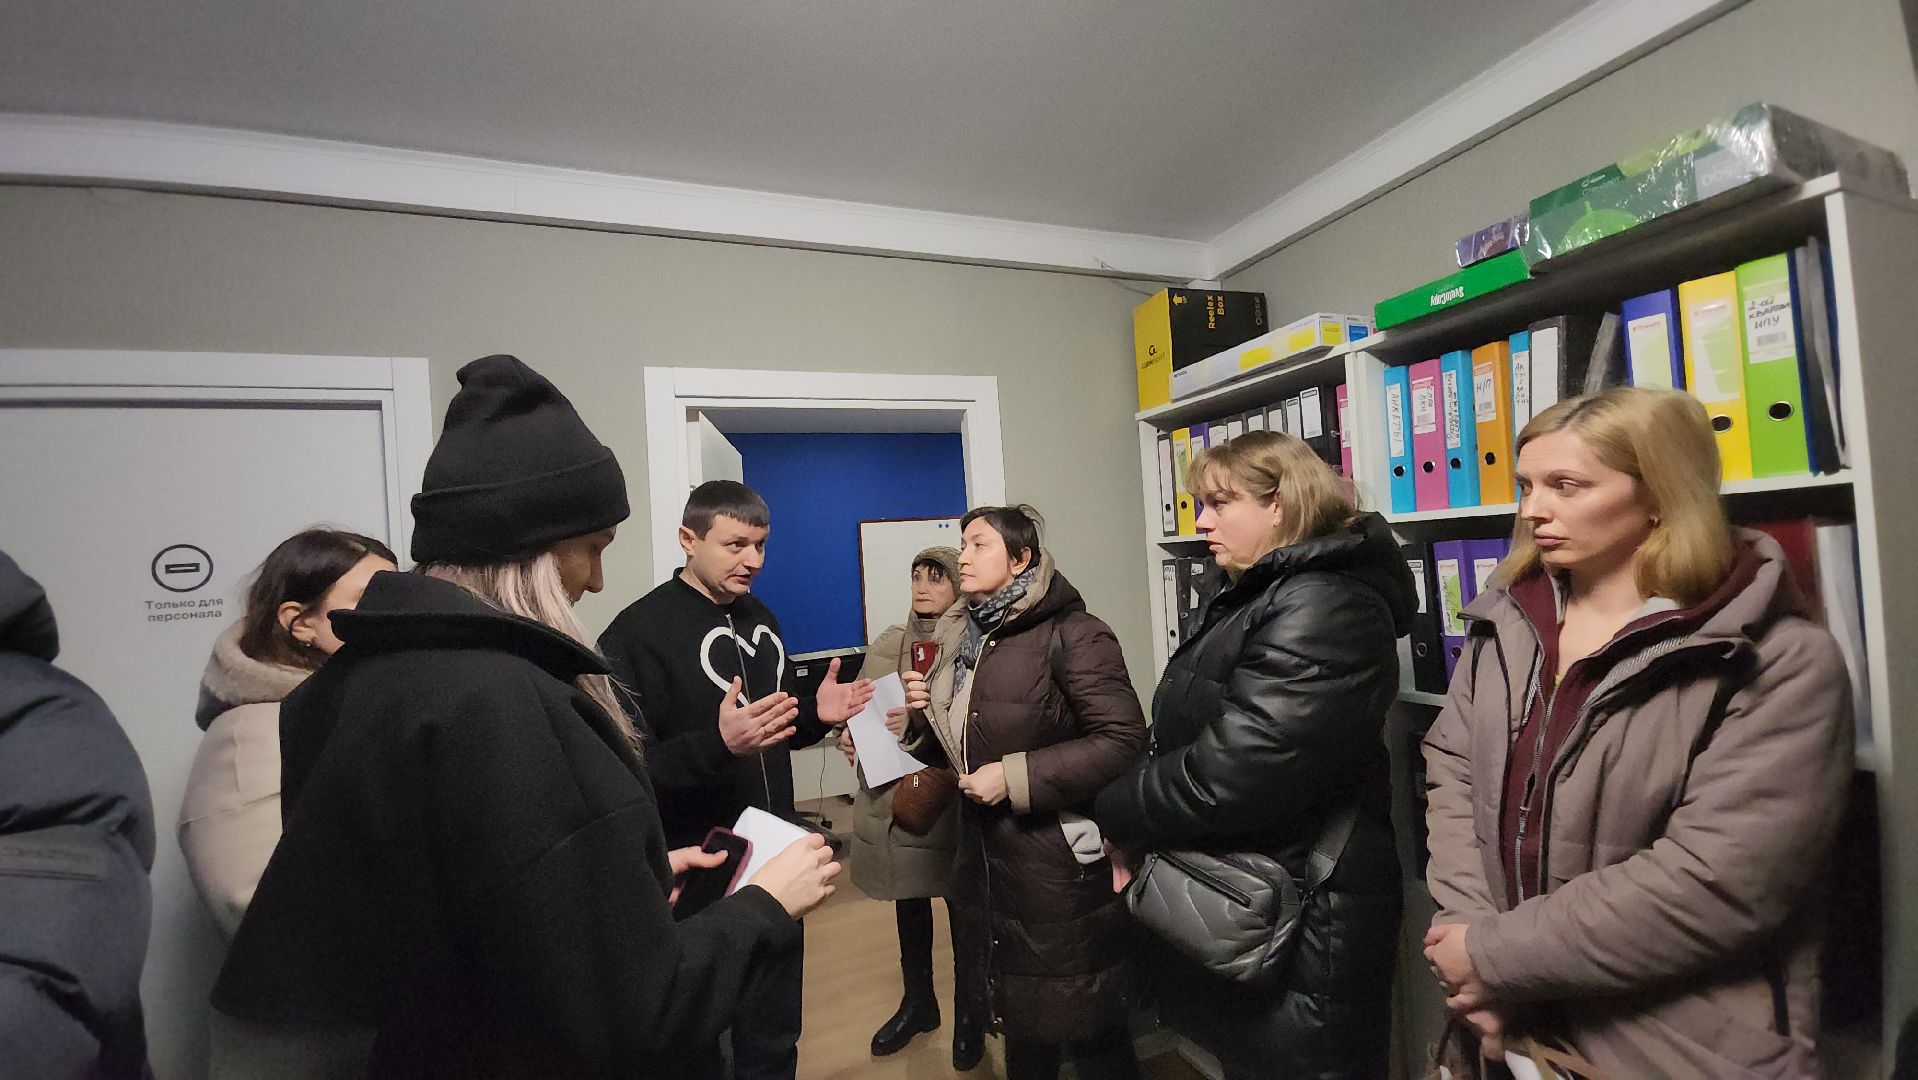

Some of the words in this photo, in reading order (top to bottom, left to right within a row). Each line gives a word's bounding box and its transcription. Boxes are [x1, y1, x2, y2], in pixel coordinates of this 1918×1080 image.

[1217, 295, 1225, 316] Box
[1430, 286, 1465, 307] SvetoCopy
[1207, 294, 1216, 329] Reelex
[145, 600, 196, 611] Только
[198, 598, 224, 608] для
[147, 611, 223, 623] персонала
